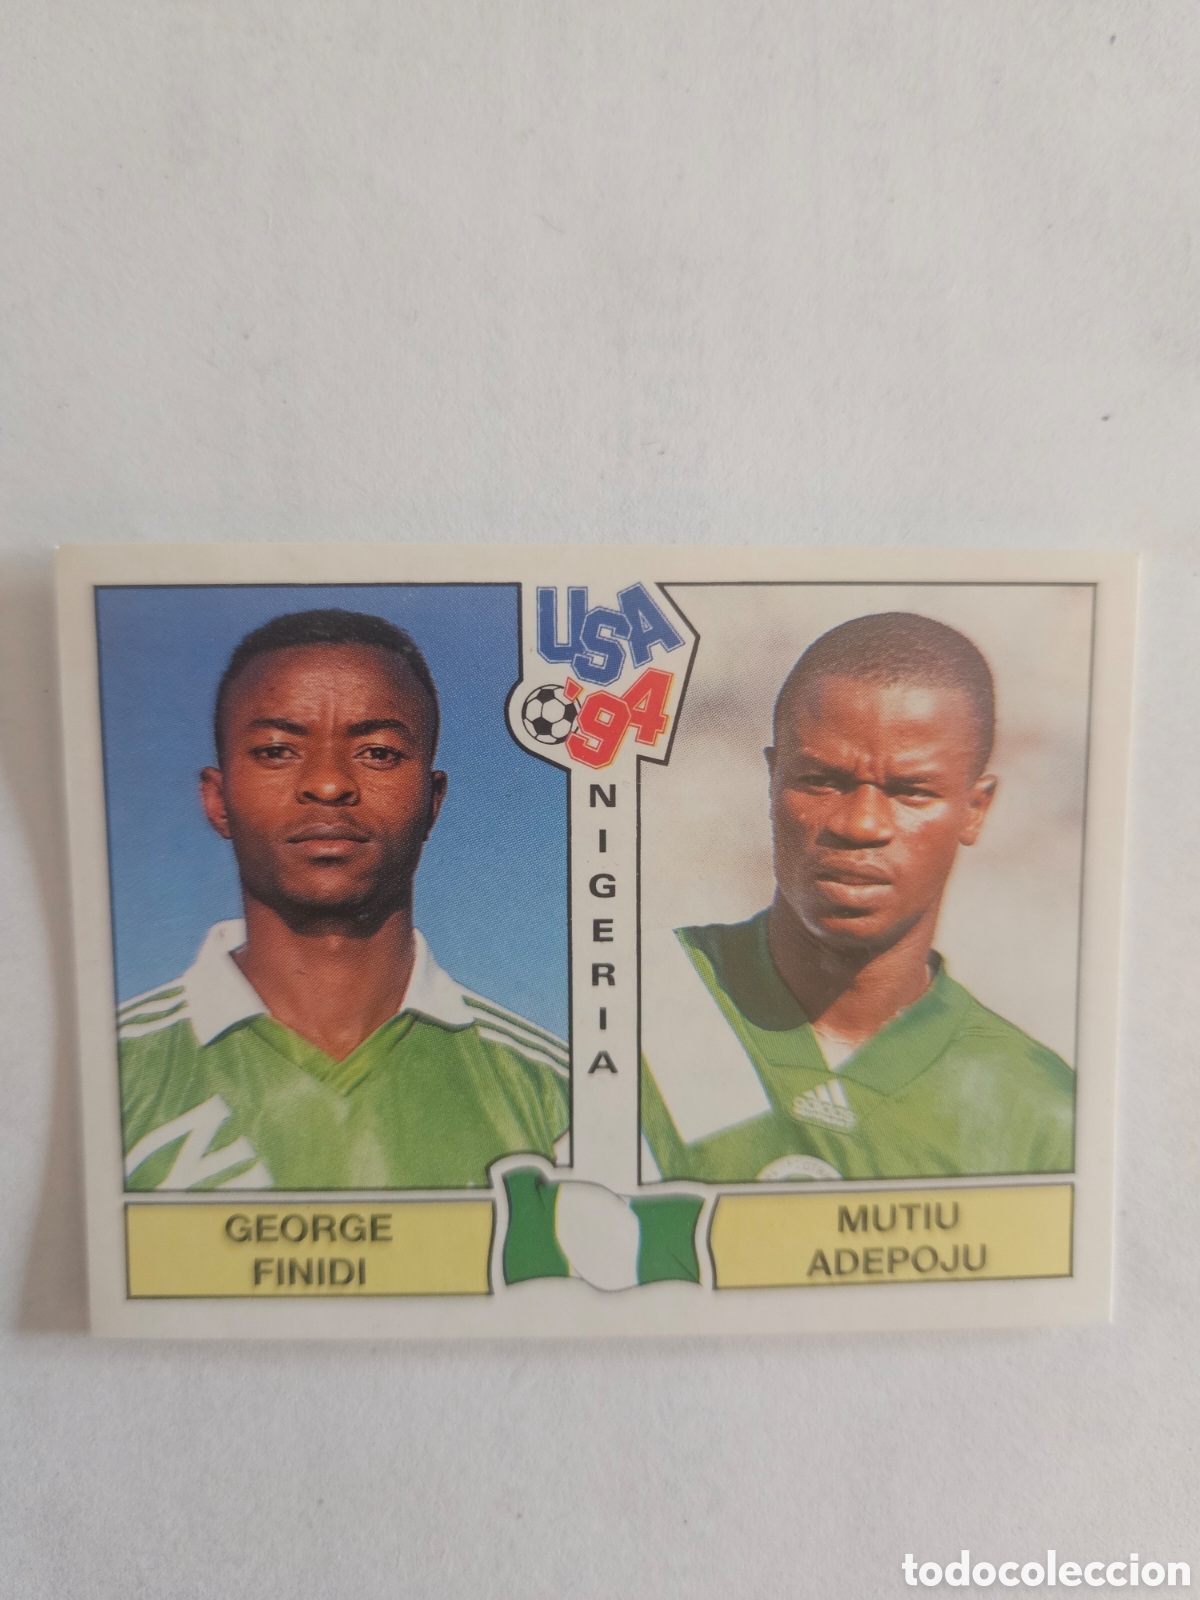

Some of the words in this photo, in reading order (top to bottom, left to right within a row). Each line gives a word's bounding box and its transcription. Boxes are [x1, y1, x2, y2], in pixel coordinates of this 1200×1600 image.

[536, 582, 685, 687] USA
[588, 784, 618, 1074] NIGERIA
[225, 1212, 393, 1243] GEORGE
[837, 1201, 959, 1233] MUTIU
[254, 1256, 366, 1286] FINIDI
[806, 1243, 987, 1277] ADEPOJU
